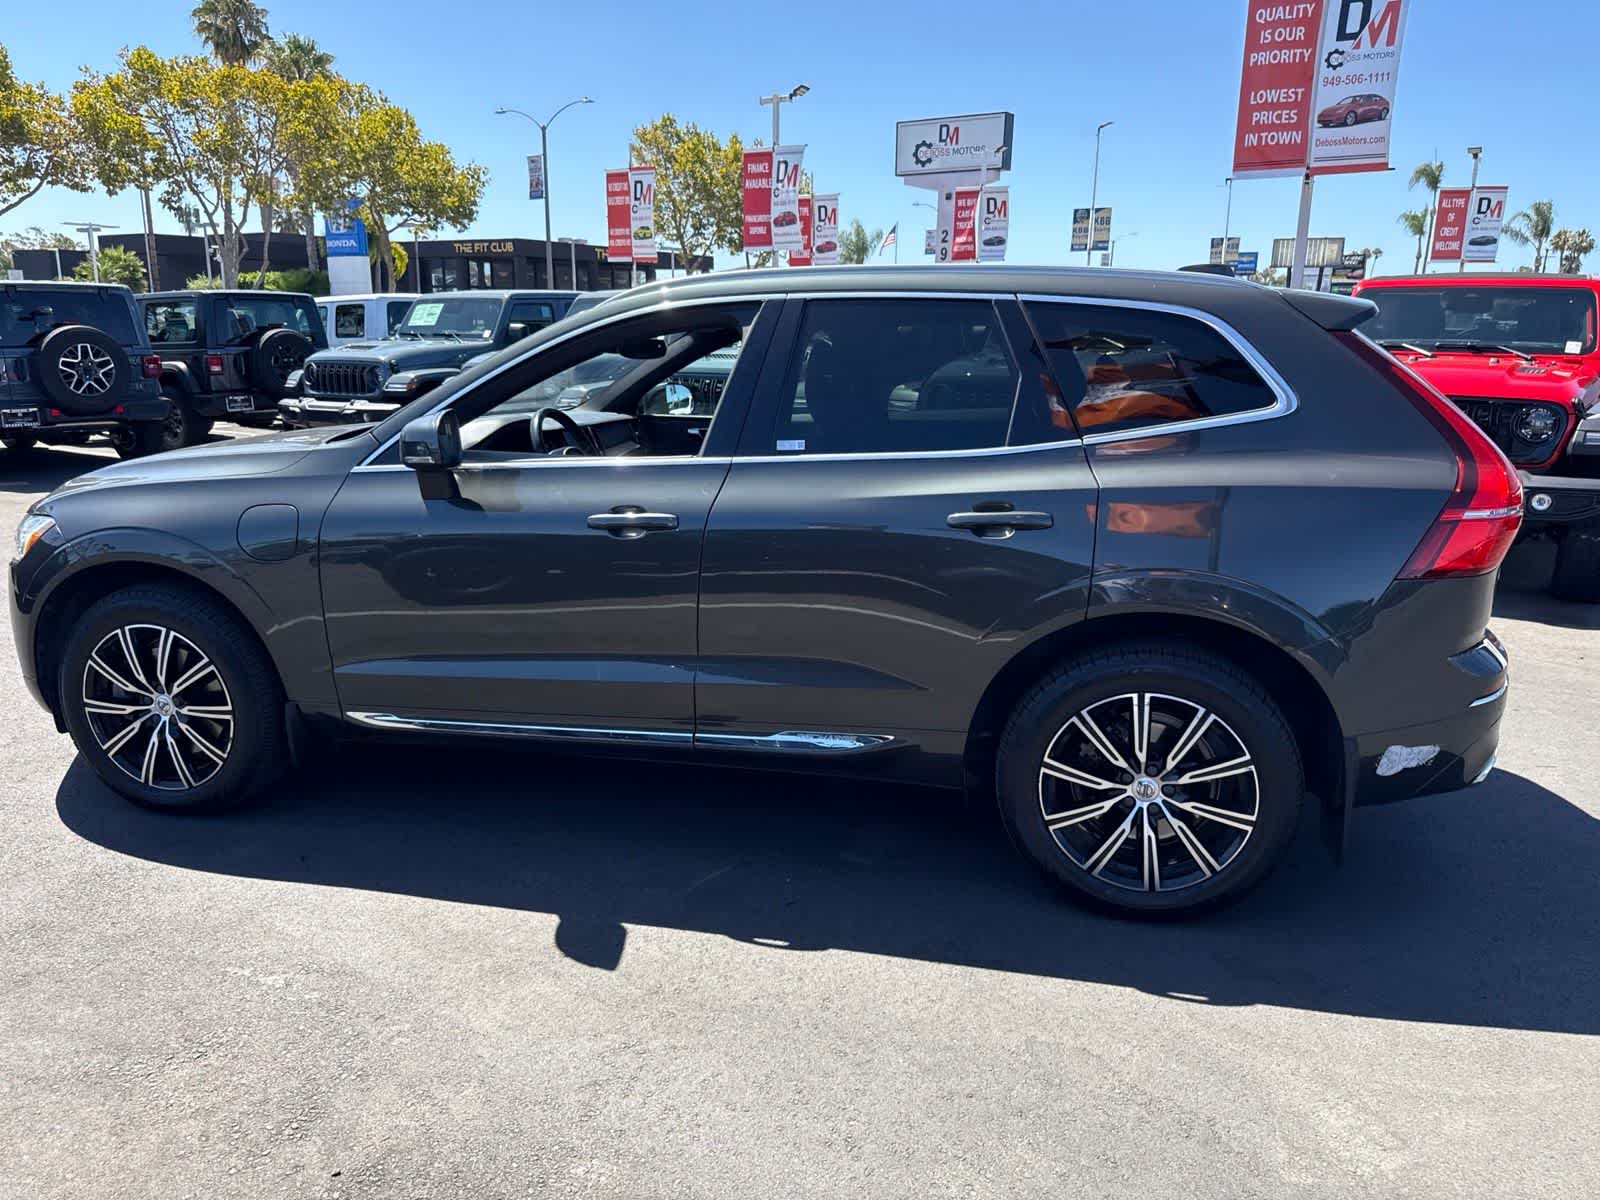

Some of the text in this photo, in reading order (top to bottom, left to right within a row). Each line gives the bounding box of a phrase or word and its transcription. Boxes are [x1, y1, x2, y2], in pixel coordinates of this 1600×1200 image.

[1255, 3, 1316, 24] QUALITY
[1336, 0, 1402, 49] DM
[1260, 26, 1306, 44] IS OUR
[1249, 48, 1313, 67] PRIORITY
[1363, 50, 1396, 61] MOTORS
[1322, 71, 1391, 87] 949-506-1111
[1250, 88, 1305, 105] LOWEST
[1251, 110, 1299, 126] PRICES
[938, 123, 960, 146] DM
[1244, 131, 1303, 148] IN TOWN
[776, 159, 800, 189] DM
[633, 180, 653, 206] DM
[817, 204, 837, 226] DM
[986, 196, 1008, 219] DM
[1477, 196, 1503, 219] DM
[454, 241, 515, 253] THE FIT CLUB
